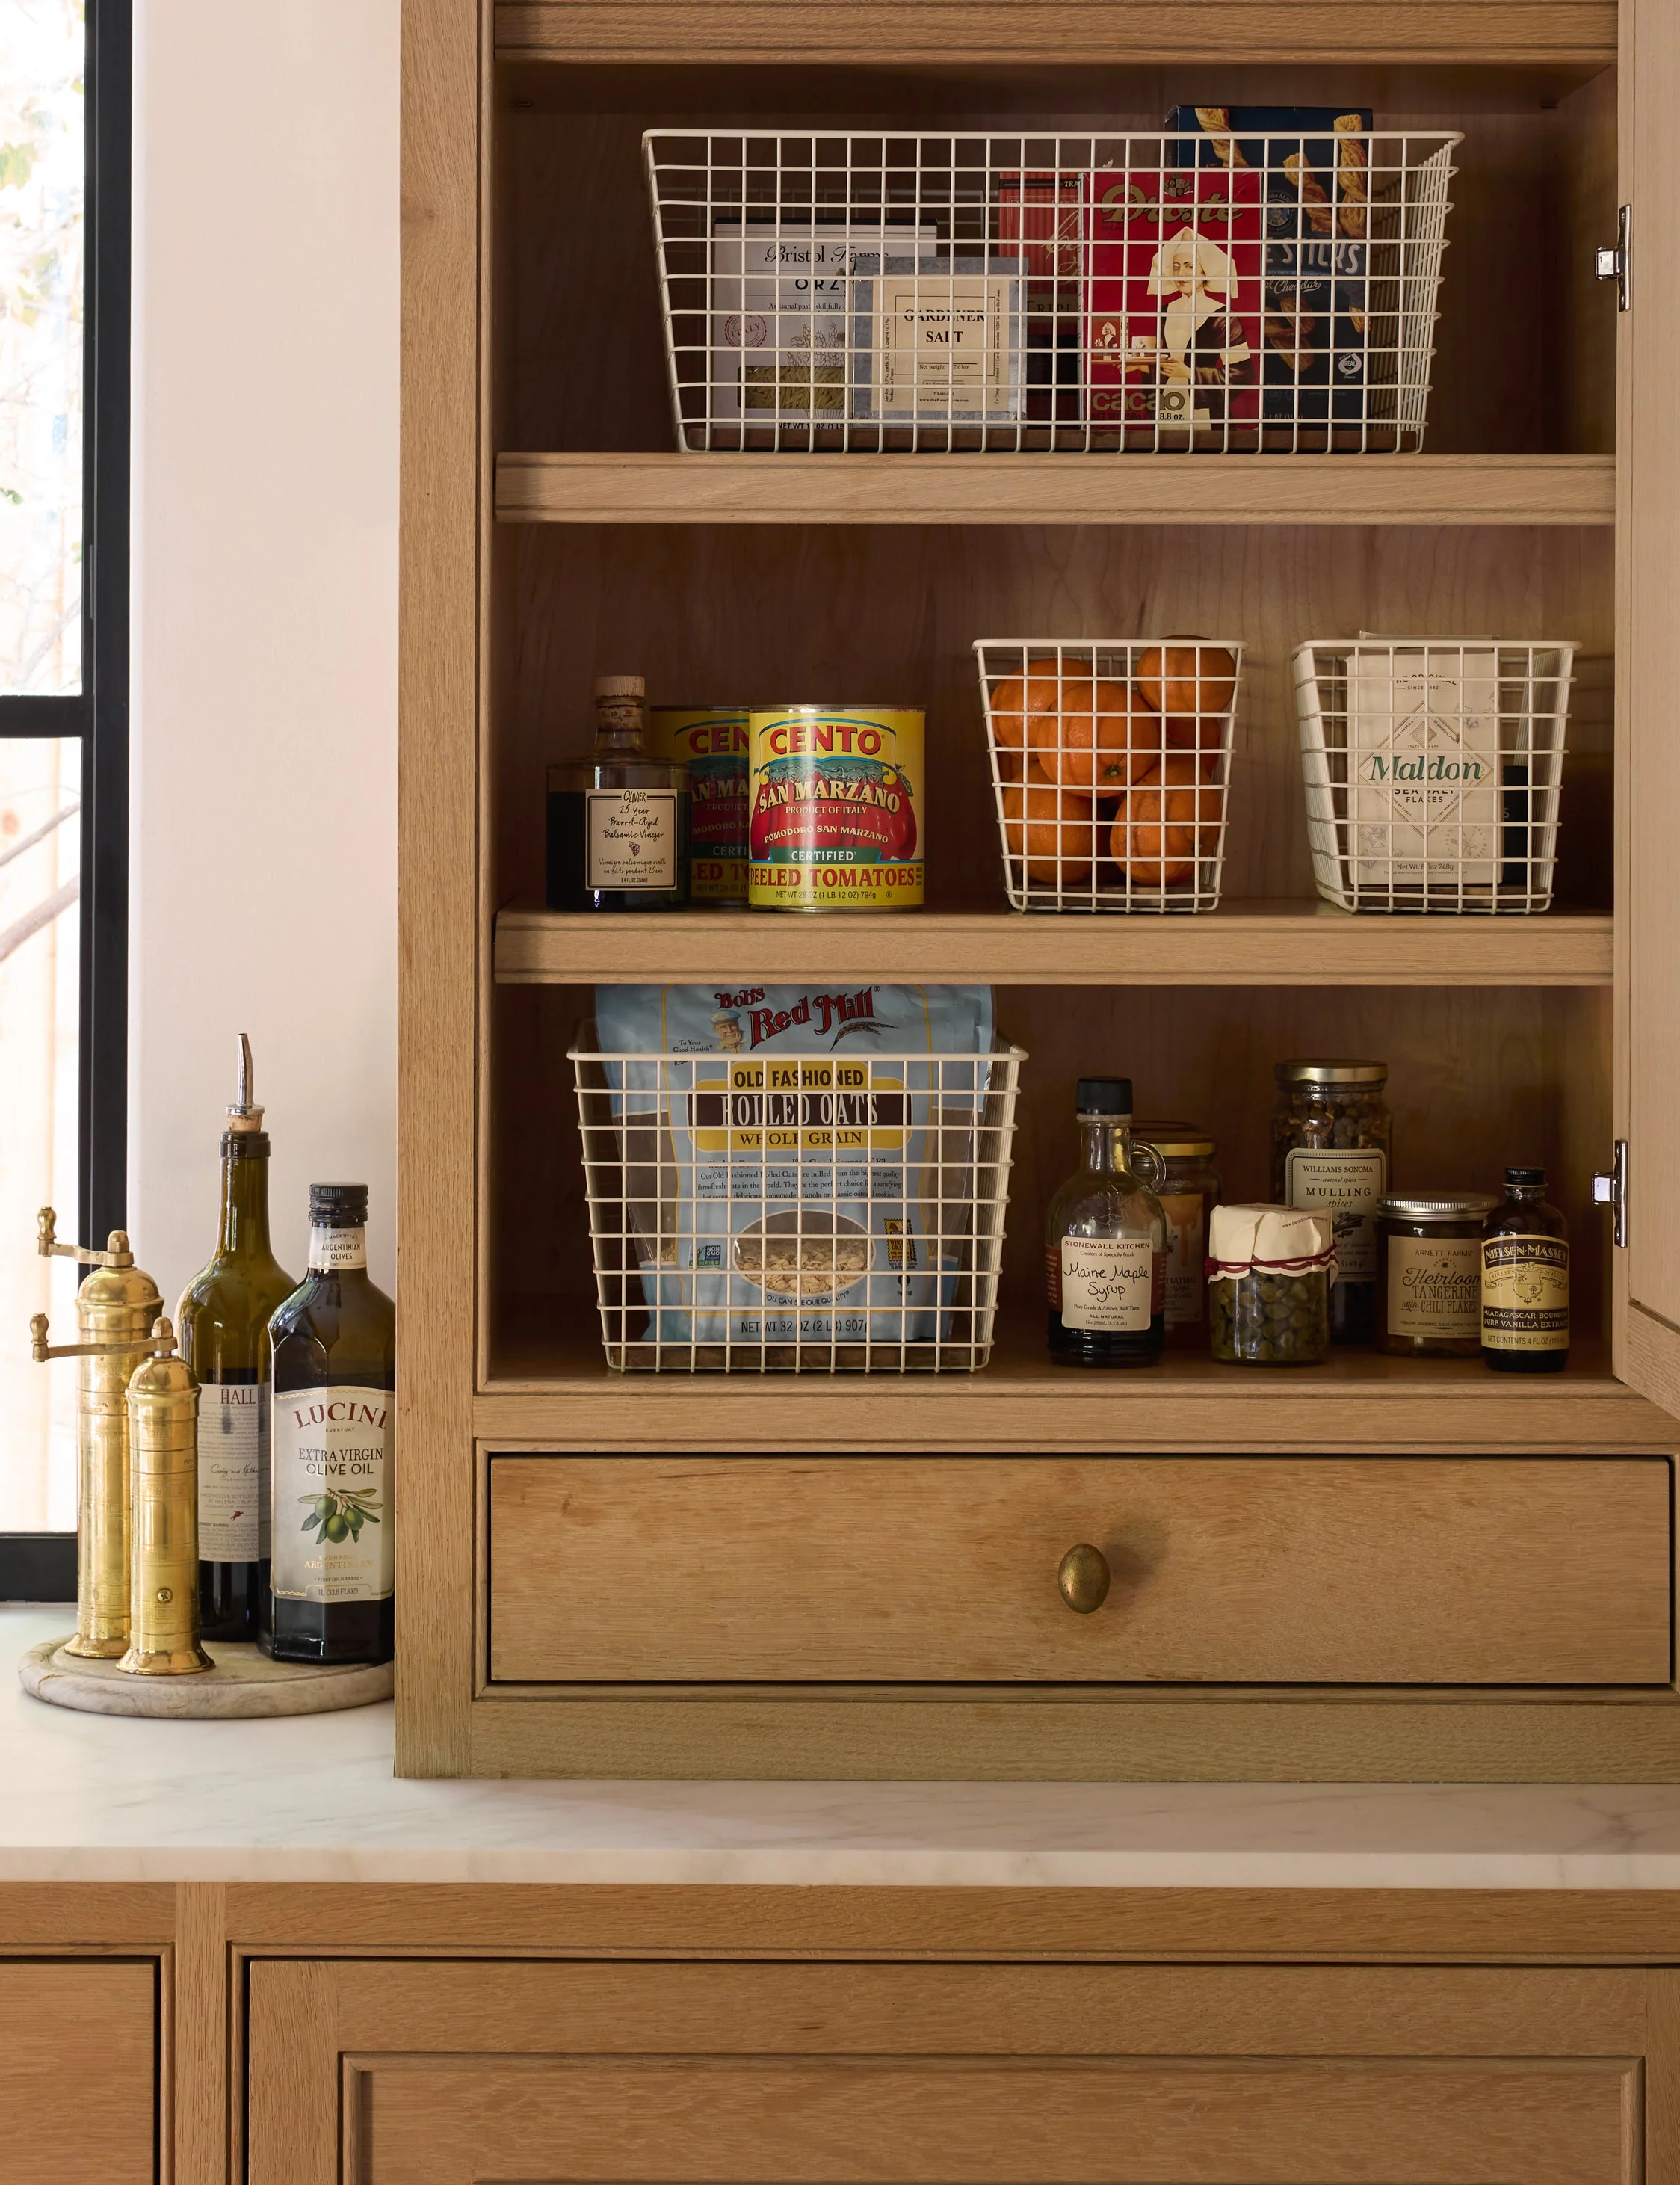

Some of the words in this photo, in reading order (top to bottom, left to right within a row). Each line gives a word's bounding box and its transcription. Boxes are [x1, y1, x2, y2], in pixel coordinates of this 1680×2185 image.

[1100, 183, 1244, 223] Droste
[765, 245, 825, 262] Bristol
[815, 303, 842, 311] skillfully
[1092, 391, 1185, 411] cacao
[1159, 413, 1172, 421] 8.8
[770, 724, 882, 755] CENTO
[1368, 756, 1483, 780] Maldon
[623, 790, 646, 803] OLIVIER
[759, 782, 790, 815] SAN
[794, 780, 901, 815] MARZANO
[620, 804, 631, 814] 25
[632, 805, 650, 816] Year
[707, 804, 747, 812] PRODUCT
[785, 806, 825, 814] PRODUCT
[827, 806, 841, 814] OF
[842, 806, 868, 815] ITALY
[608, 816, 660, 830] Barrel-Aged
[602, 828, 640, 839] Balsamic
[639, 829, 664, 842] Vinegar
[764, 825, 814, 844] POMODORO
[816, 825, 838, 833] SAN
[840, 826, 889, 843] MARZANO
[791, 851, 855, 861] CERTIFIED
[750, 867, 802, 886] PEELED
[809, 867, 915, 887] TOMATOES
[860, 890, 877, 899] 794g
[714, 987, 767, 1009] Bob's
[747, 995, 812, 1051] Red
[812, 986, 877, 1035] Mill
[734, 1070, 763, 1088] OLD
[772, 1070, 864, 1087] FASHIONED
[720, 1094, 810, 1126] ROLLED
[819, 1094, 878, 1125] OATS
[738, 1132, 803, 1145] WHOLE
[808, 1132, 863, 1144] GRAIN
[882, 1170, 901, 1178] quality
[697, 1183, 726, 1191] farm-fresh
[877, 1181, 901, 1189] satisfying
[1305, 1187, 1372, 1197] MULLING
[1327, 1198, 1353, 1209] spices
[1064, 1240, 1114, 1250] STONEWALL
[1063, 1261, 1107, 1278] Maine
[1109, 1265, 1149, 1284] Maple
[806, 1298, 821, 1306] OUR
[821, 1292, 847, 1304] QULITY
[1087, 1281, 1126, 1303] Syrup
[1412, 1285, 1479, 1300] TANGERINE
[1400, 1299, 1419, 1311] with
[1421, 1300, 1444, 1313] CHILI
[1447, 1301, 1477, 1314] FLAKES
[741, 1322, 761, 1333] NET
[765, 1321, 778, 1332] WT
[780, 1321, 793, 1332] 32
[812, 1320, 823, 1333] (2
[1483, 1318, 1499, 1326] PURE
[1501, 1319, 1539, 1328] VANILLA
[1496, 1335, 1526, 1344] CONTENTS
[220, 1388, 256, 1405] HALL
[293, 1401, 388, 1429] LUCINI
[298, 1447, 338, 1462] EXTRA
[339, 1447, 384, 1461] VIRGIN
[306, 1463, 346, 1476] OLIVE
[351, 1462, 374, 1474] OIL
[303, 1559, 374, 1570] ARGENTINIAN
